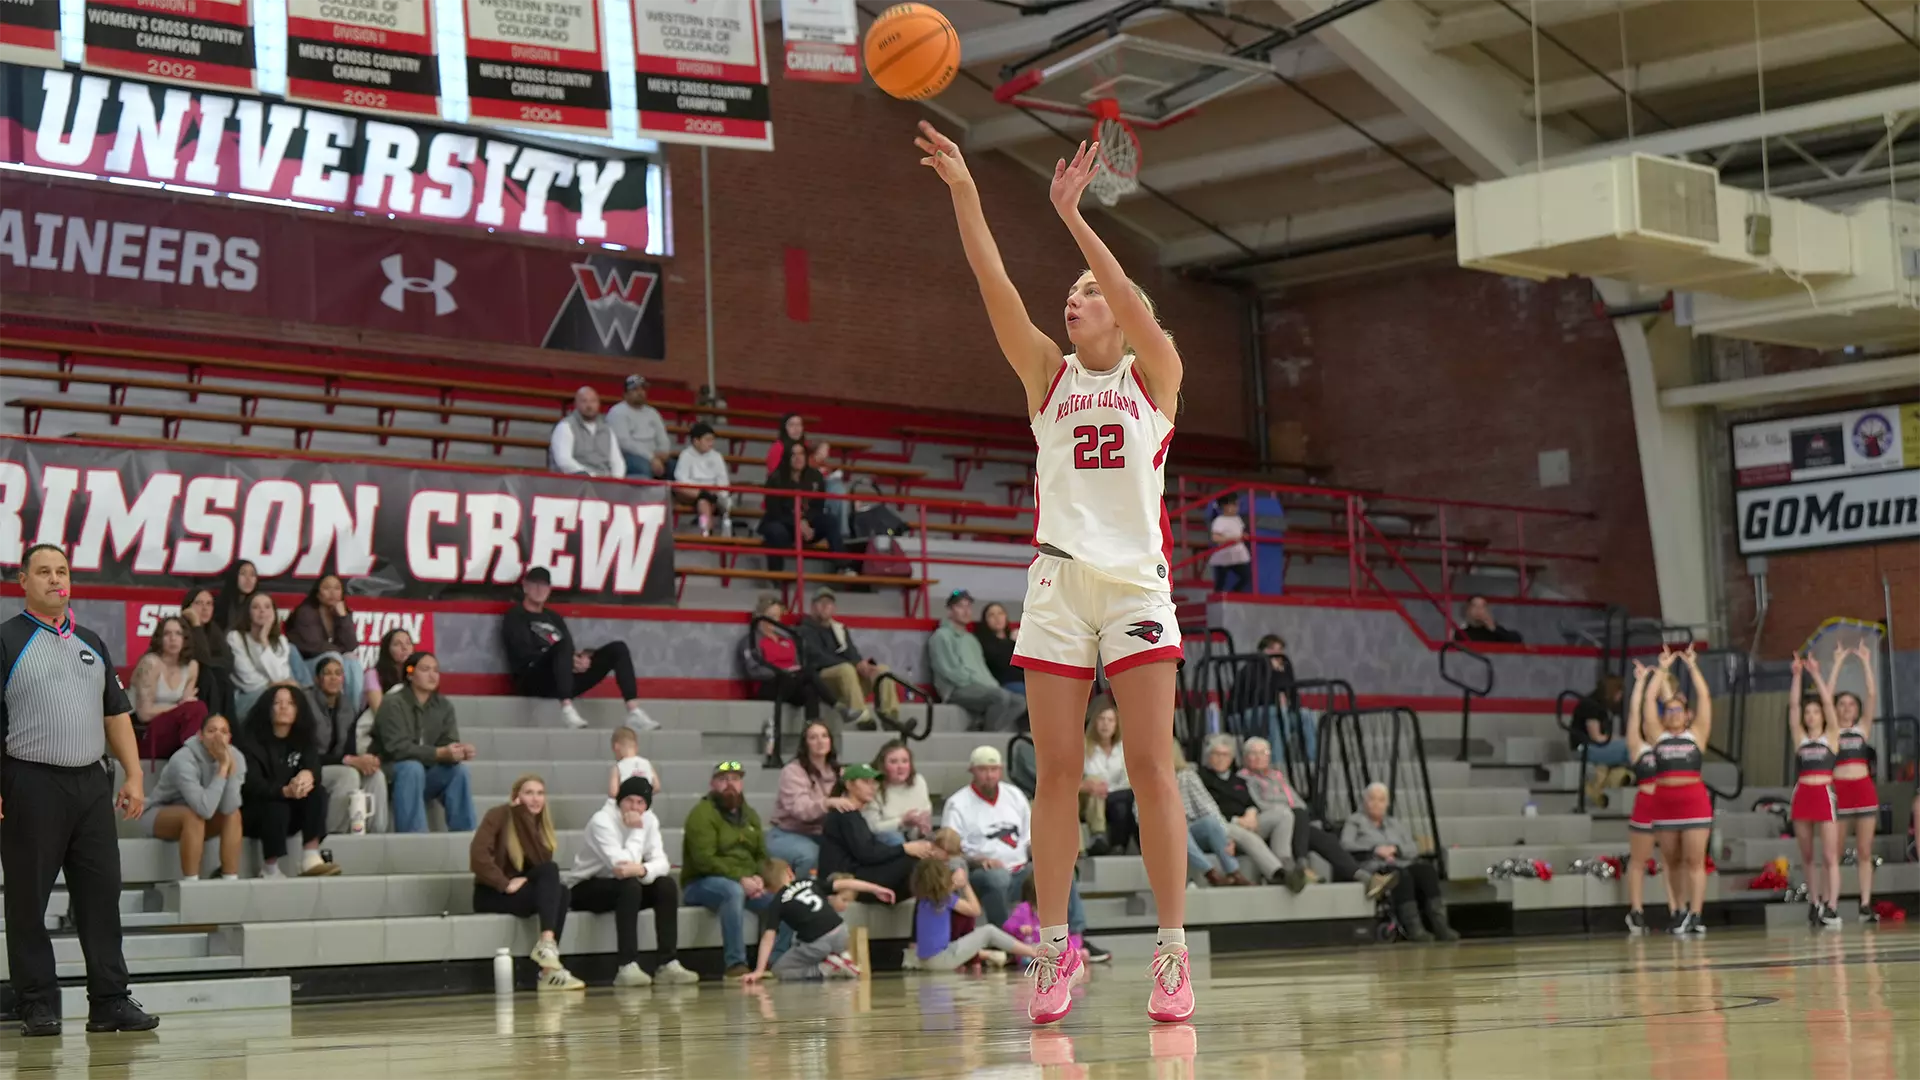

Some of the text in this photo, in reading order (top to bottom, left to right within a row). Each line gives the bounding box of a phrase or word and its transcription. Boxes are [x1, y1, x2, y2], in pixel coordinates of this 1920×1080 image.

[319, 4, 398, 27] COLORADO
[494, 9, 570, 29] COLLEGE OF
[545, 3, 582, 19] STATE
[645, 10, 741, 32] WESTERN STATE
[88, 9, 244, 46] WOMEN'S CROSS COUNTRY
[333, 24, 378, 43] DIVISION
[497, 23, 569, 42] COLORADO
[660, 24, 731, 42] COLLEGE OF
[136, 32, 201, 56] CHAMPION
[662, 38, 731, 56] COLORADO
[298, 43, 421, 73] MEN'S CROSS COUNTRY
[786, 51, 858, 74] CHAMPION
[147, 59, 197, 79] 2002
[332, 64, 392, 85] CHAMPION
[479, 63, 593, 88] MEN'S CROSS COUNTRY
[343, 89, 388, 108] 2002
[511, 81, 566, 100] CHAMPION
[647, 77, 752, 101] MEN'S CROSS COUNTRY
[520, 106, 563, 122] 2004
[676, 94, 727, 113] CHAMPION
[35, 69, 625, 239] UNIVERSITY
[1073, 424, 1126, 470] 22
[406, 489, 667, 594] CREW
[794, 888, 823, 912] 5
